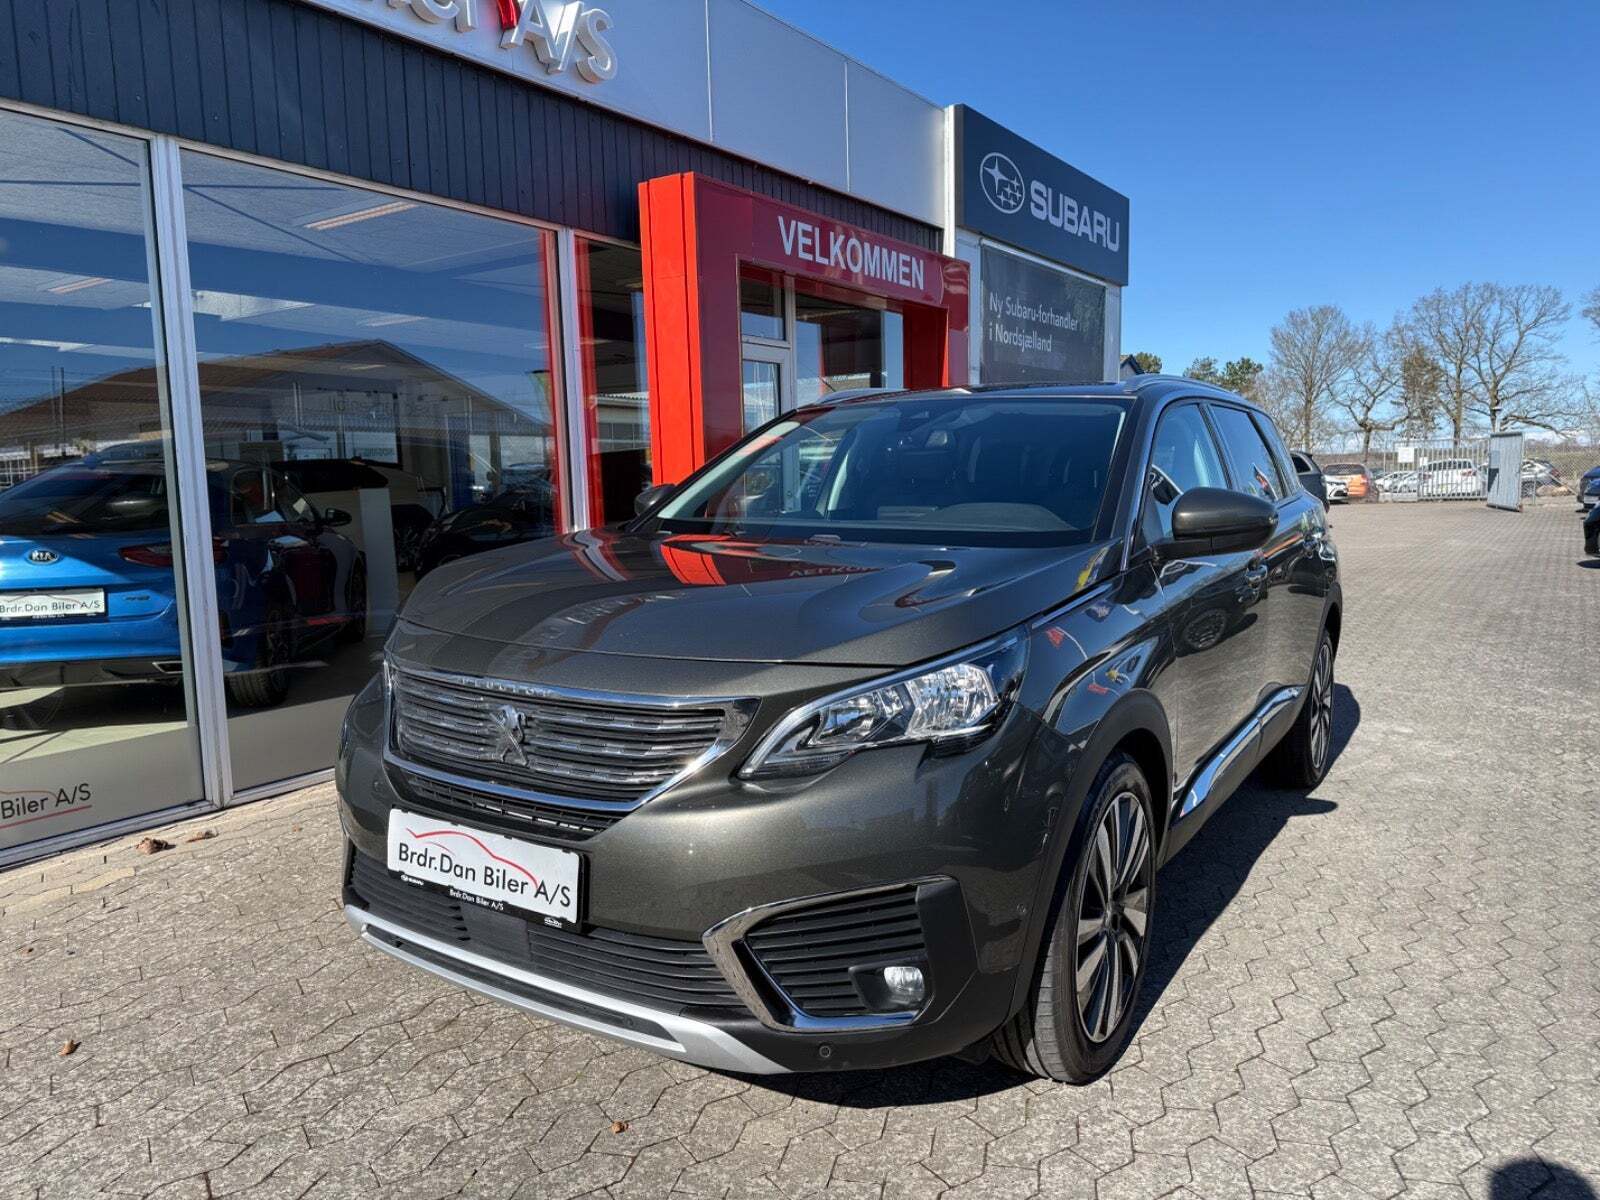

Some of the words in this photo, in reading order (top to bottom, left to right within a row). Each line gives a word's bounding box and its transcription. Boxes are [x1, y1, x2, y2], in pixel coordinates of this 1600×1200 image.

[499, 0, 617, 83] A/S
[1030, 179, 1120, 252] SUBARU
[778, 215, 925, 291] VELKOMMEN
[989, 292, 1004, 318] Ny
[1005, 296, 1079, 332] Subaru-forhandler
[995, 323, 1053, 353] Nordsjælland
[31, 550, 55, 561] KIA
[52, 600, 76, 611] Biler
[80, 600, 101, 610] A/S
[0, 796, 49, 820] Biler
[55, 782, 92, 808] A/S
[398, 843, 476, 882] Brdr.Dan
[483, 866, 529, 895] Biler
[534, 880, 572, 908] A/S
